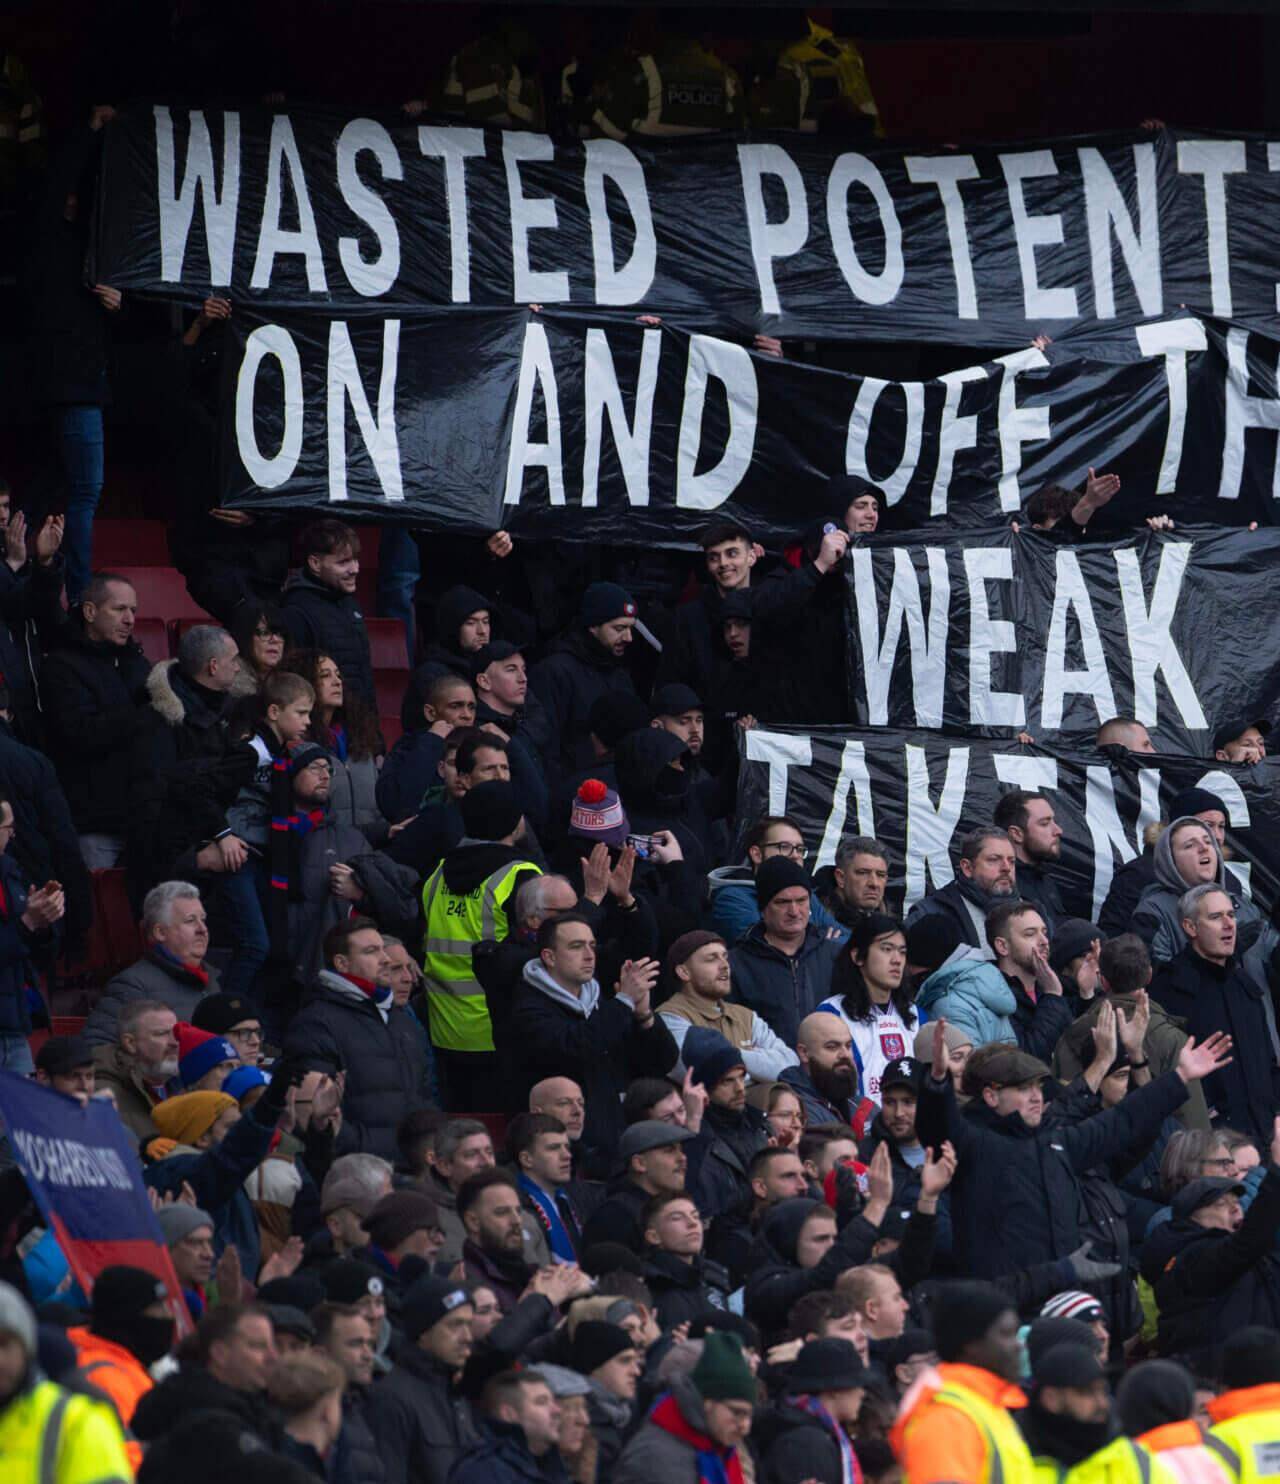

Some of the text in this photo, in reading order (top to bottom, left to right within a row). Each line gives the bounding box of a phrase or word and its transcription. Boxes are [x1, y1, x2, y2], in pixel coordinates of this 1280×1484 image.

[153, 105, 657, 306] WASTED
[236, 318, 404, 503] ON
[504, 321, 759, 511] AND
[846, 346, 1052, 517] OFF
[851, 542, 1210, 731] WEAK
